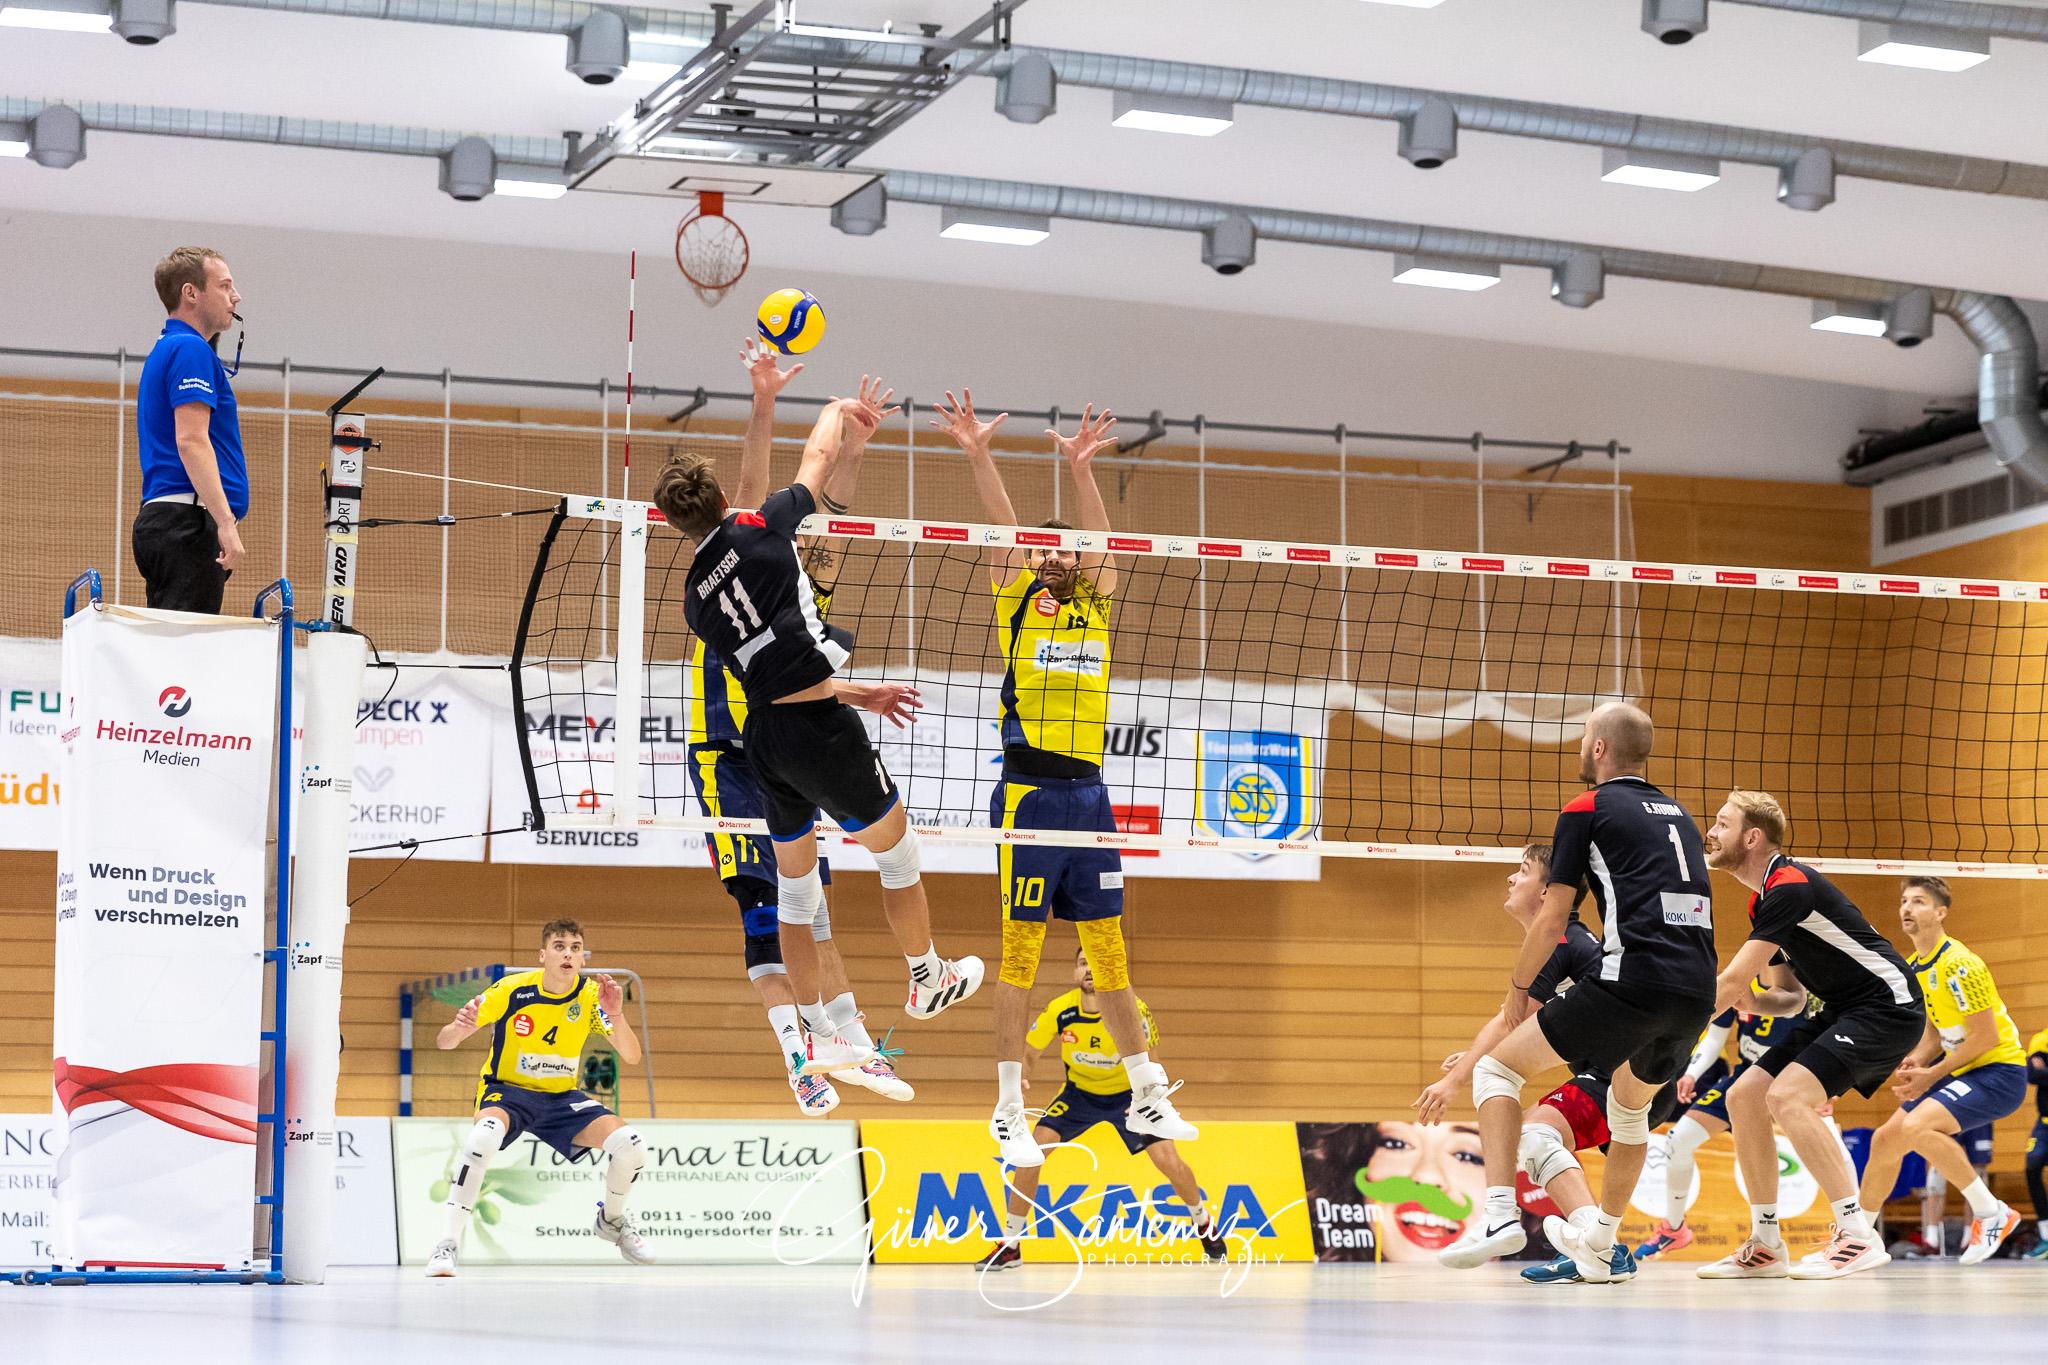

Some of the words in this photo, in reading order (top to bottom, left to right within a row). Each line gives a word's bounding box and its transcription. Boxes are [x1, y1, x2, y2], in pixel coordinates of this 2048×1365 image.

[697, 548, 740, 600] BRAETSCH
[331, 546, 348, 624] ERARD
[719, 576, 762, 640] 11
[9, 719, 57, 736] Ideen
[96, 719, 252, 752] Heinzelmann
[524, 713, 684, 743] MEYEL
[142, 749, 200, 768] Medien
[307, 778, 332, 788] Zapf
[536, 831, 639, 847] SERVICES
[1668, 823, 1691, 882] 1
[89, 862, 147, 882] Wenn
[152, 865, 216, 886] Druck
[128, 886, 168, 904] und
[174, 888, 247, 912] Design
[1014, 876, 1045, 907] 10
[94, 907, 239, 928] verschmelzen
[297, 955, 323, 965] Zapf
[542, 1025, 559, 1046] 4
[1755, 1015, 1774, 1037] 3
[483, 1092, 502, 1103] 4
[1696, 1088, 1722, 1106] 3
[1047, 1100, 1069, 1117] 6
[289, 1131, 314, 1142] Zapf
[733, 1135, 833, 1167] Elia
[536, 1170, 594, 1182] GREEK
[755, 1170, 824, 1182] CUISINE
[641, 1210, 682, 1221] 0911
[703, 1210, 734, 1221] 500
[742, 1210, 772, 1221] 200
[1315, 1196, 1384, 1224] Dream
[779, 1226, 809, 1237] Str.
[815, 1226, 835, 1237] 21
[1317, 1222, 1375, 1249] Team
